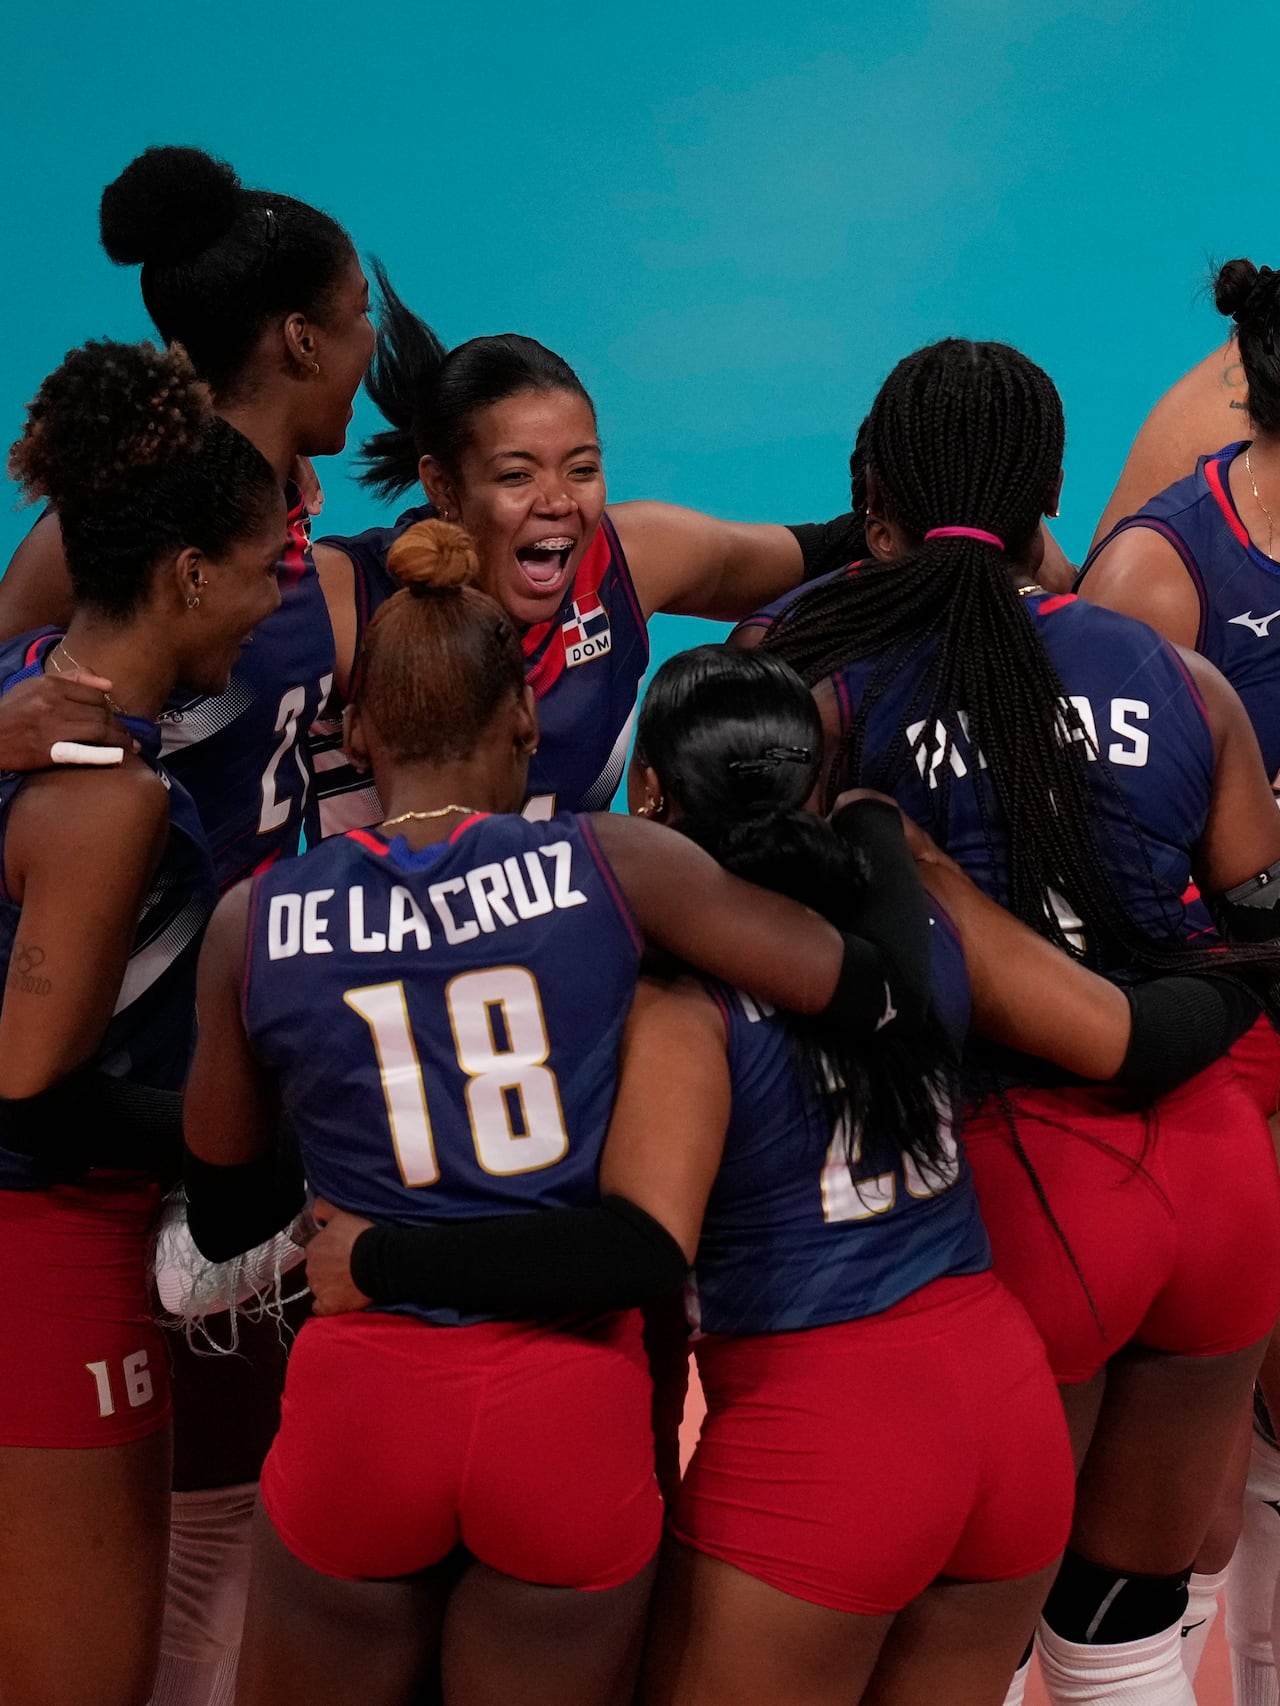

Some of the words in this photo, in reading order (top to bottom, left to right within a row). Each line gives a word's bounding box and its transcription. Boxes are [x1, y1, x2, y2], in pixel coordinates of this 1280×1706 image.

[572, 635, 610, 662] DOM
[268, 888, 335, 961] DE
[349, 885, 432, 953] LA
[428, 840, 589, 945] CRUZ
[343, 964, 570, 1188] 18
[85, 1349, 153, 1418] 16
